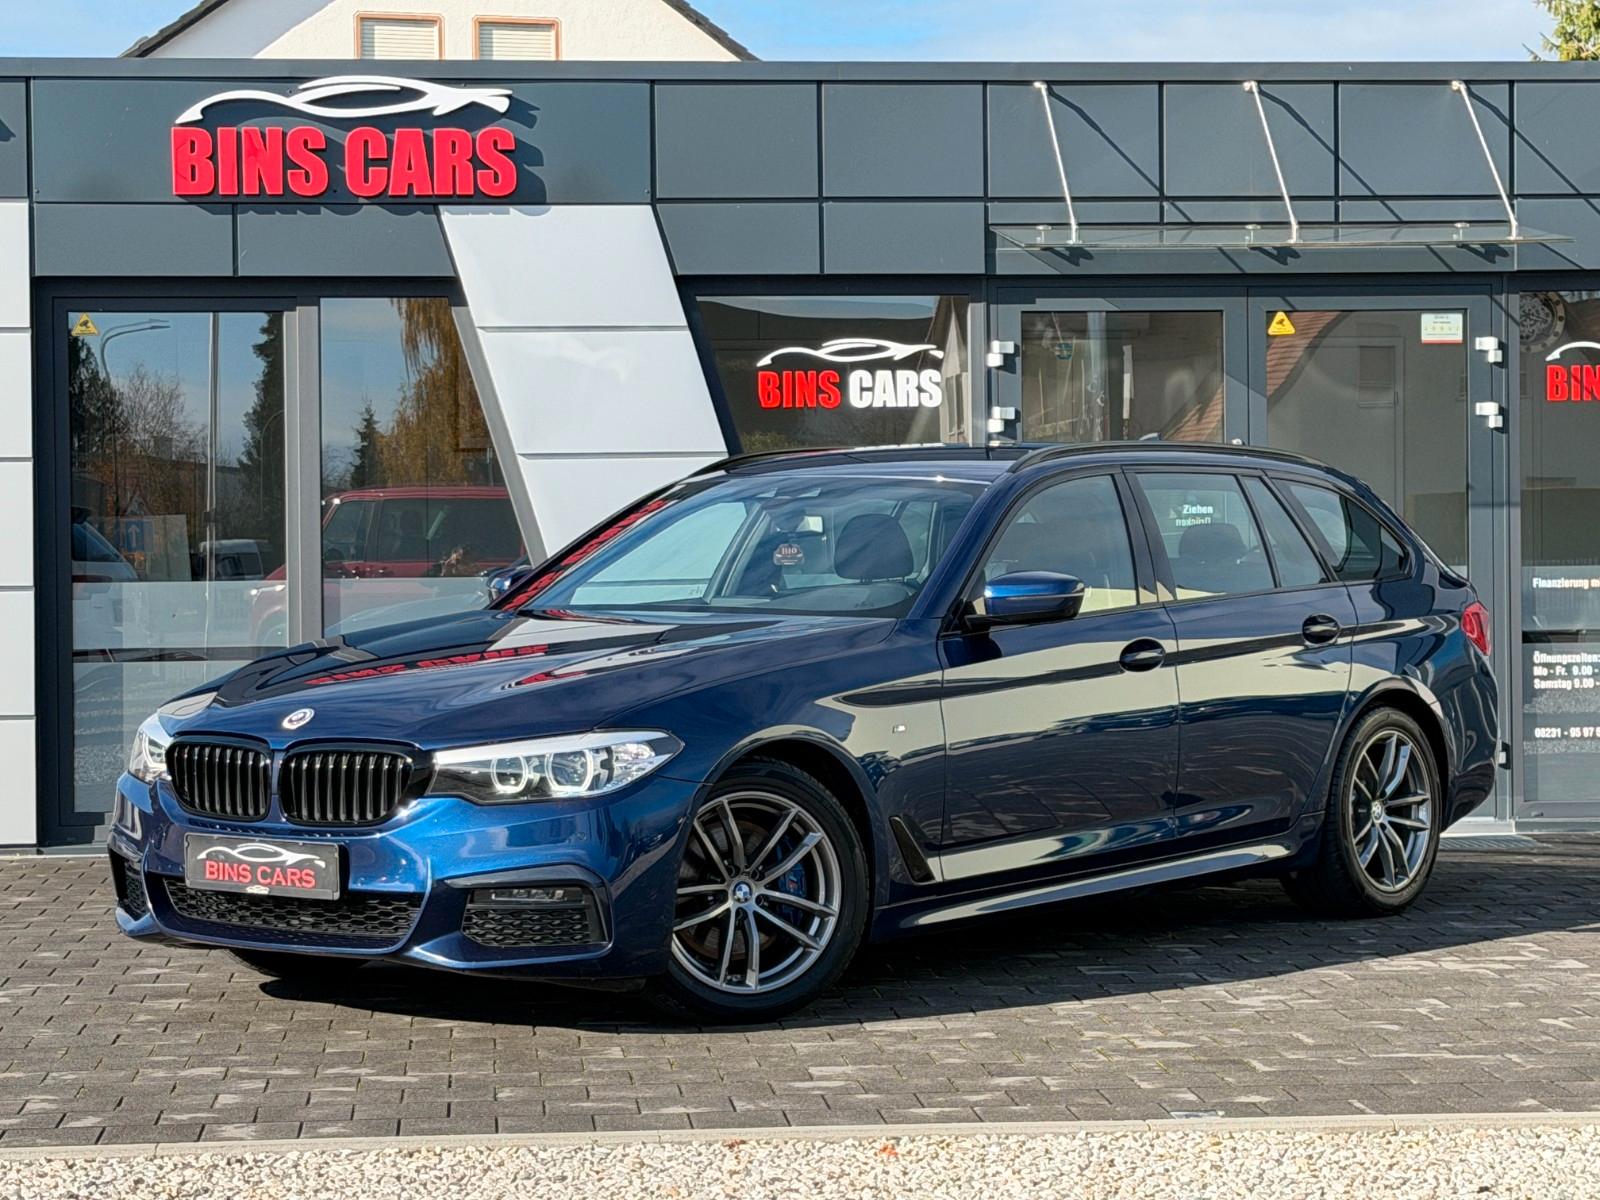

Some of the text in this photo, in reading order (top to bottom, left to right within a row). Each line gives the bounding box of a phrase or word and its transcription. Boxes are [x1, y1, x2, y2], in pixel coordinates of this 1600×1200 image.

[171, 126, 517, 197] BINS CARS
[757, 369, 943, 409] BINS CARS
[1182, 504, 1214, 514] Ziehen
[1532, 577, 1589, 590] Finanzierung
[1533, 666, 1548, 676] Mo
[1555, 665, 1568, 676] Fr.
[1533, 678, 1572, 690] Samstag
[1574, 678, 1595, 689] 9.00
[204, 860, 316, 889] BINS CARS
